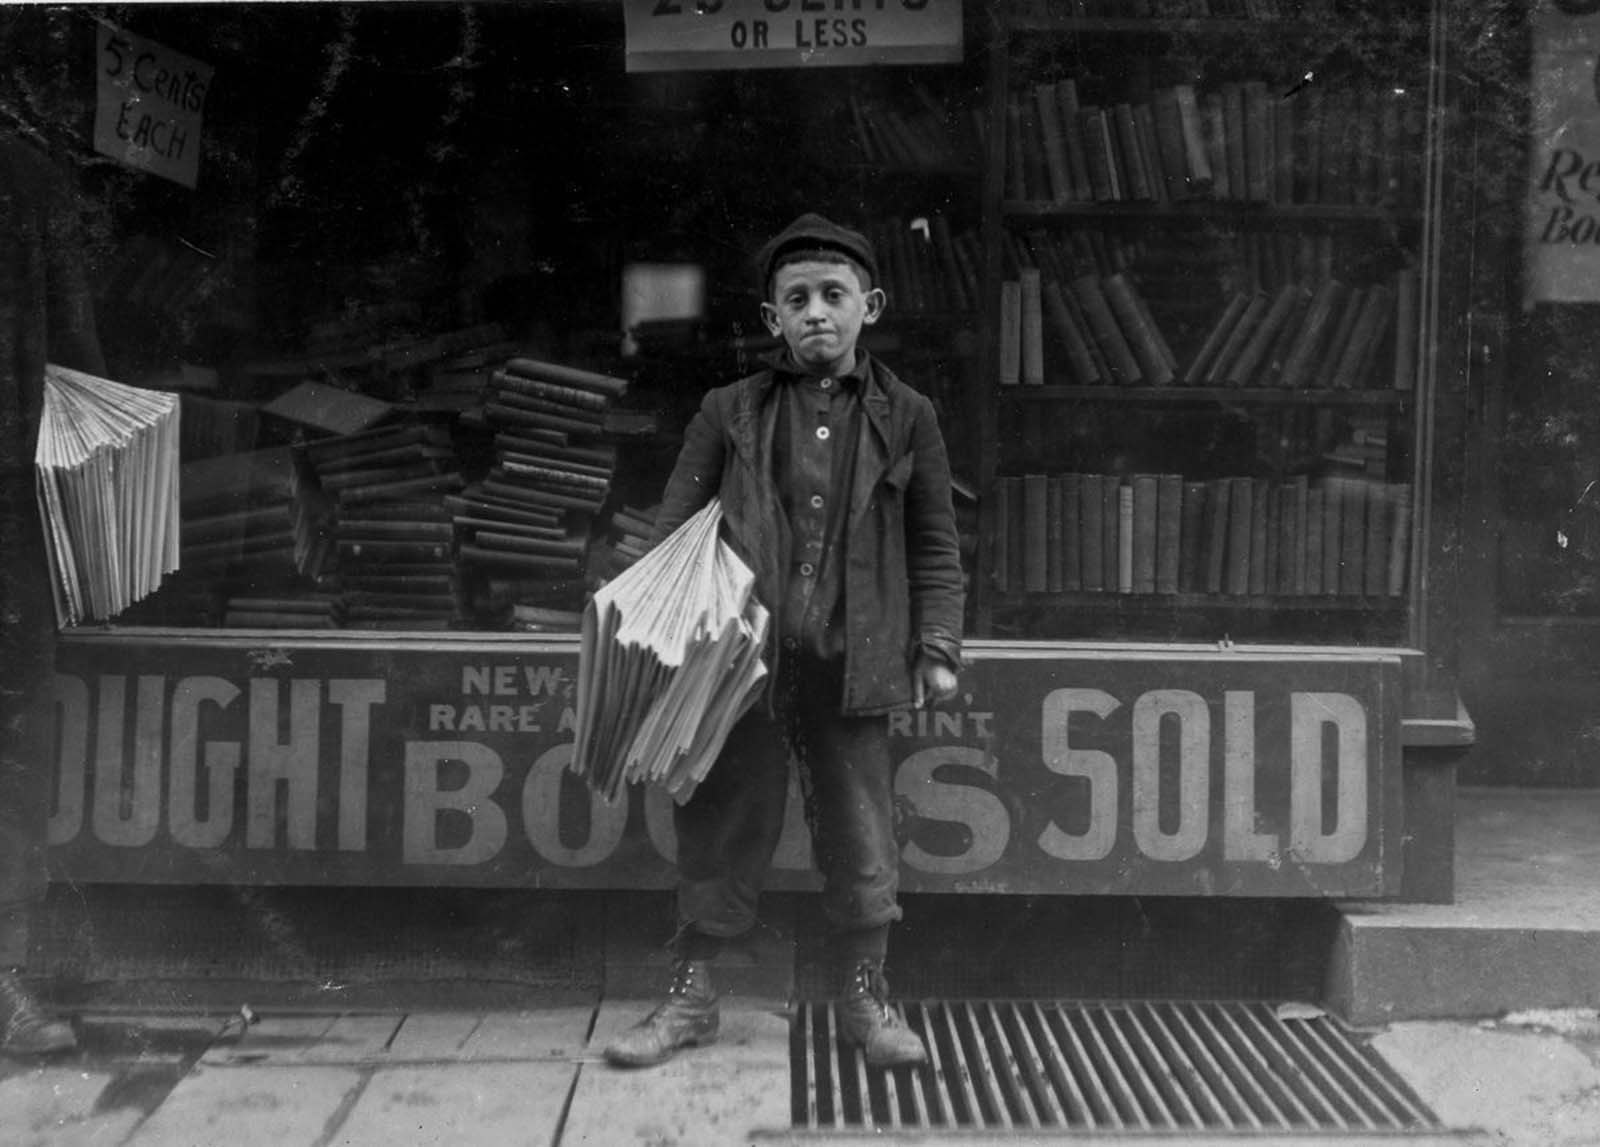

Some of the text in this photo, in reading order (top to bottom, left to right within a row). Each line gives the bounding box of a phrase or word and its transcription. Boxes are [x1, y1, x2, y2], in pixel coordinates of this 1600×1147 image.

[104, 35, 130, 77] 5
[730, 18, 868, 49] OR LESS
[116, 101, 188, 160] EACH
[428, 703, 542, 733] RARE
[1037, 687, 1368, 865] SOLD
[402, 741, 1012, 875] BOS
